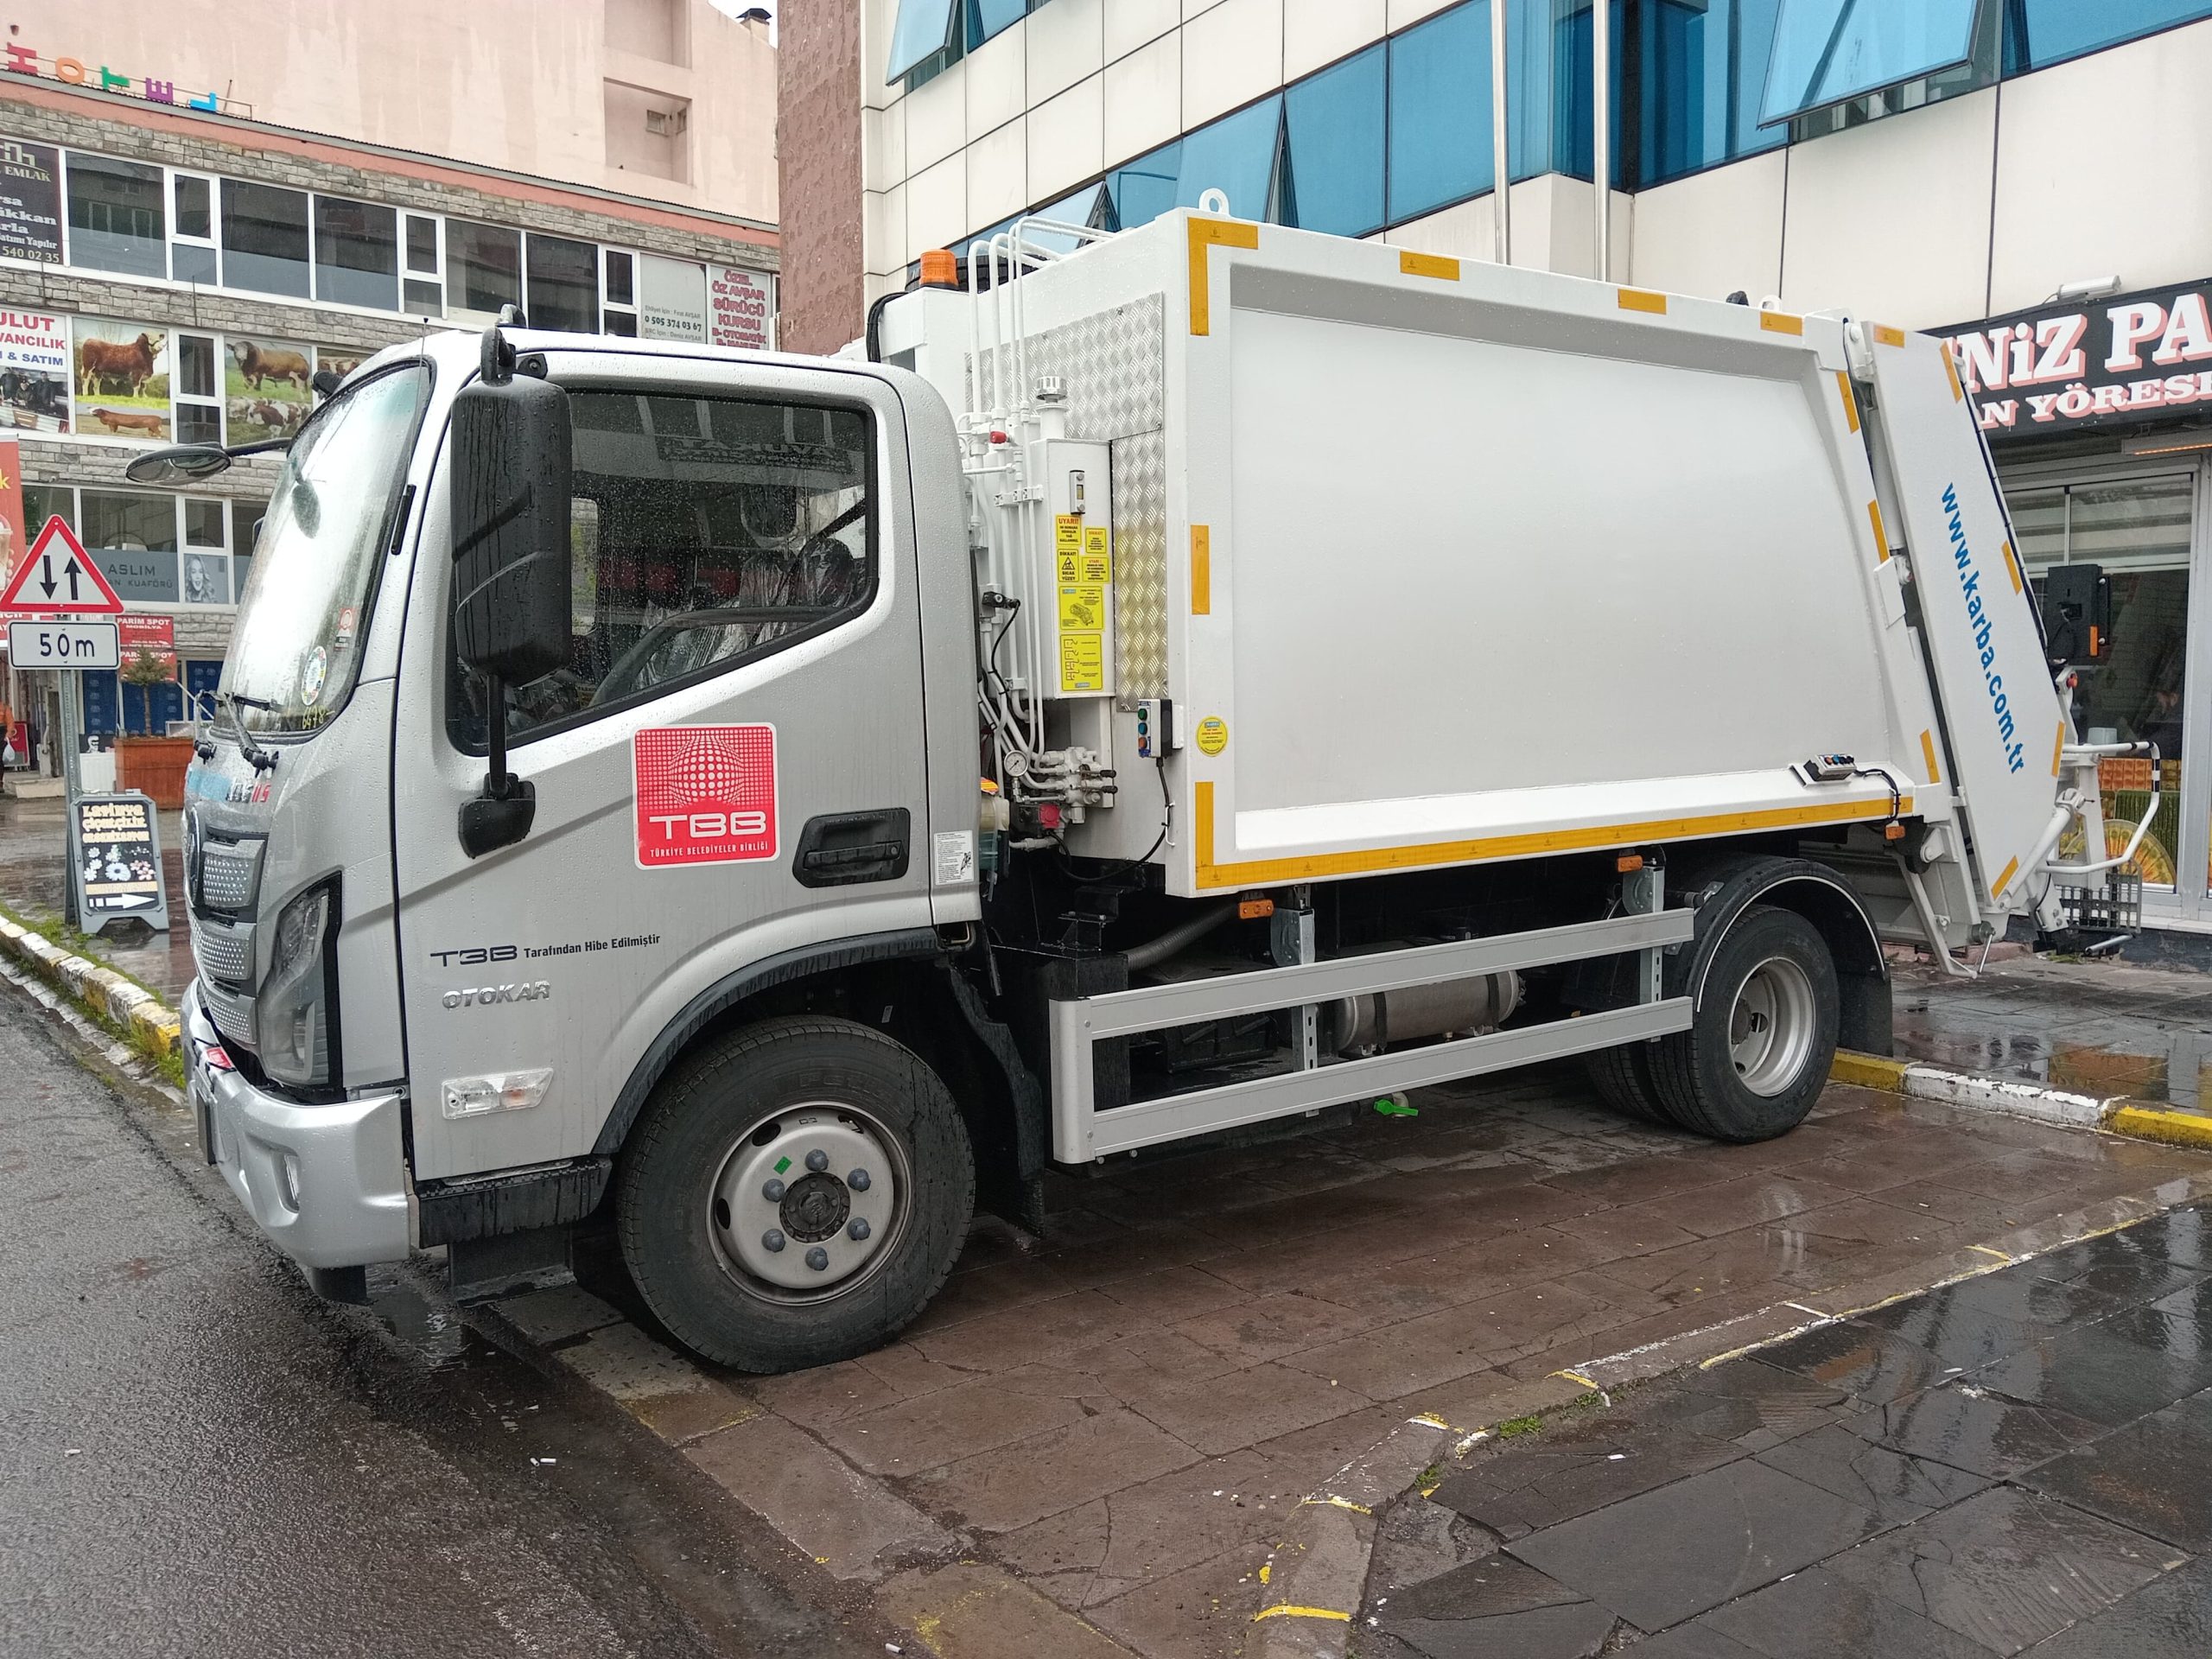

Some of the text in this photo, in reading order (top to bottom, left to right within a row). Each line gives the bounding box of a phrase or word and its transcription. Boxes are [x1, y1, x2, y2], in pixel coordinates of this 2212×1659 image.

[7, 42, 217, 114] HOTEL
[4, 165, 51, 182] EMLAK
[2, 245, 60, 264] 540 02 35
[712, 280, 728, 294] ÖZ
[713, 297, 766, 317] SÜRÜCÜ
[652, 316, 664, 326] 505
[666, 319, 680, 328] 374
[682, 321, 691, 330] 03
[718, 313, 761, 331] KURSU
[22, 353, 63, 366] SATIM
[108, 563, 156, 576] ASLIM
[1942, 482, 2024, 774] www.karba.com.tr
[649, 810, 766, 840] TBB
[651, 841, 768, 858] TÜRKİYE BELEDİYELER BİRLİĞİ
[524, 944, 582, 959] Tarafından
[585, 941, 608, 952] Hibe
[611, 934, 661, 950] Edilmiştir
[442, 980, 551, 1009] OTOKAR
